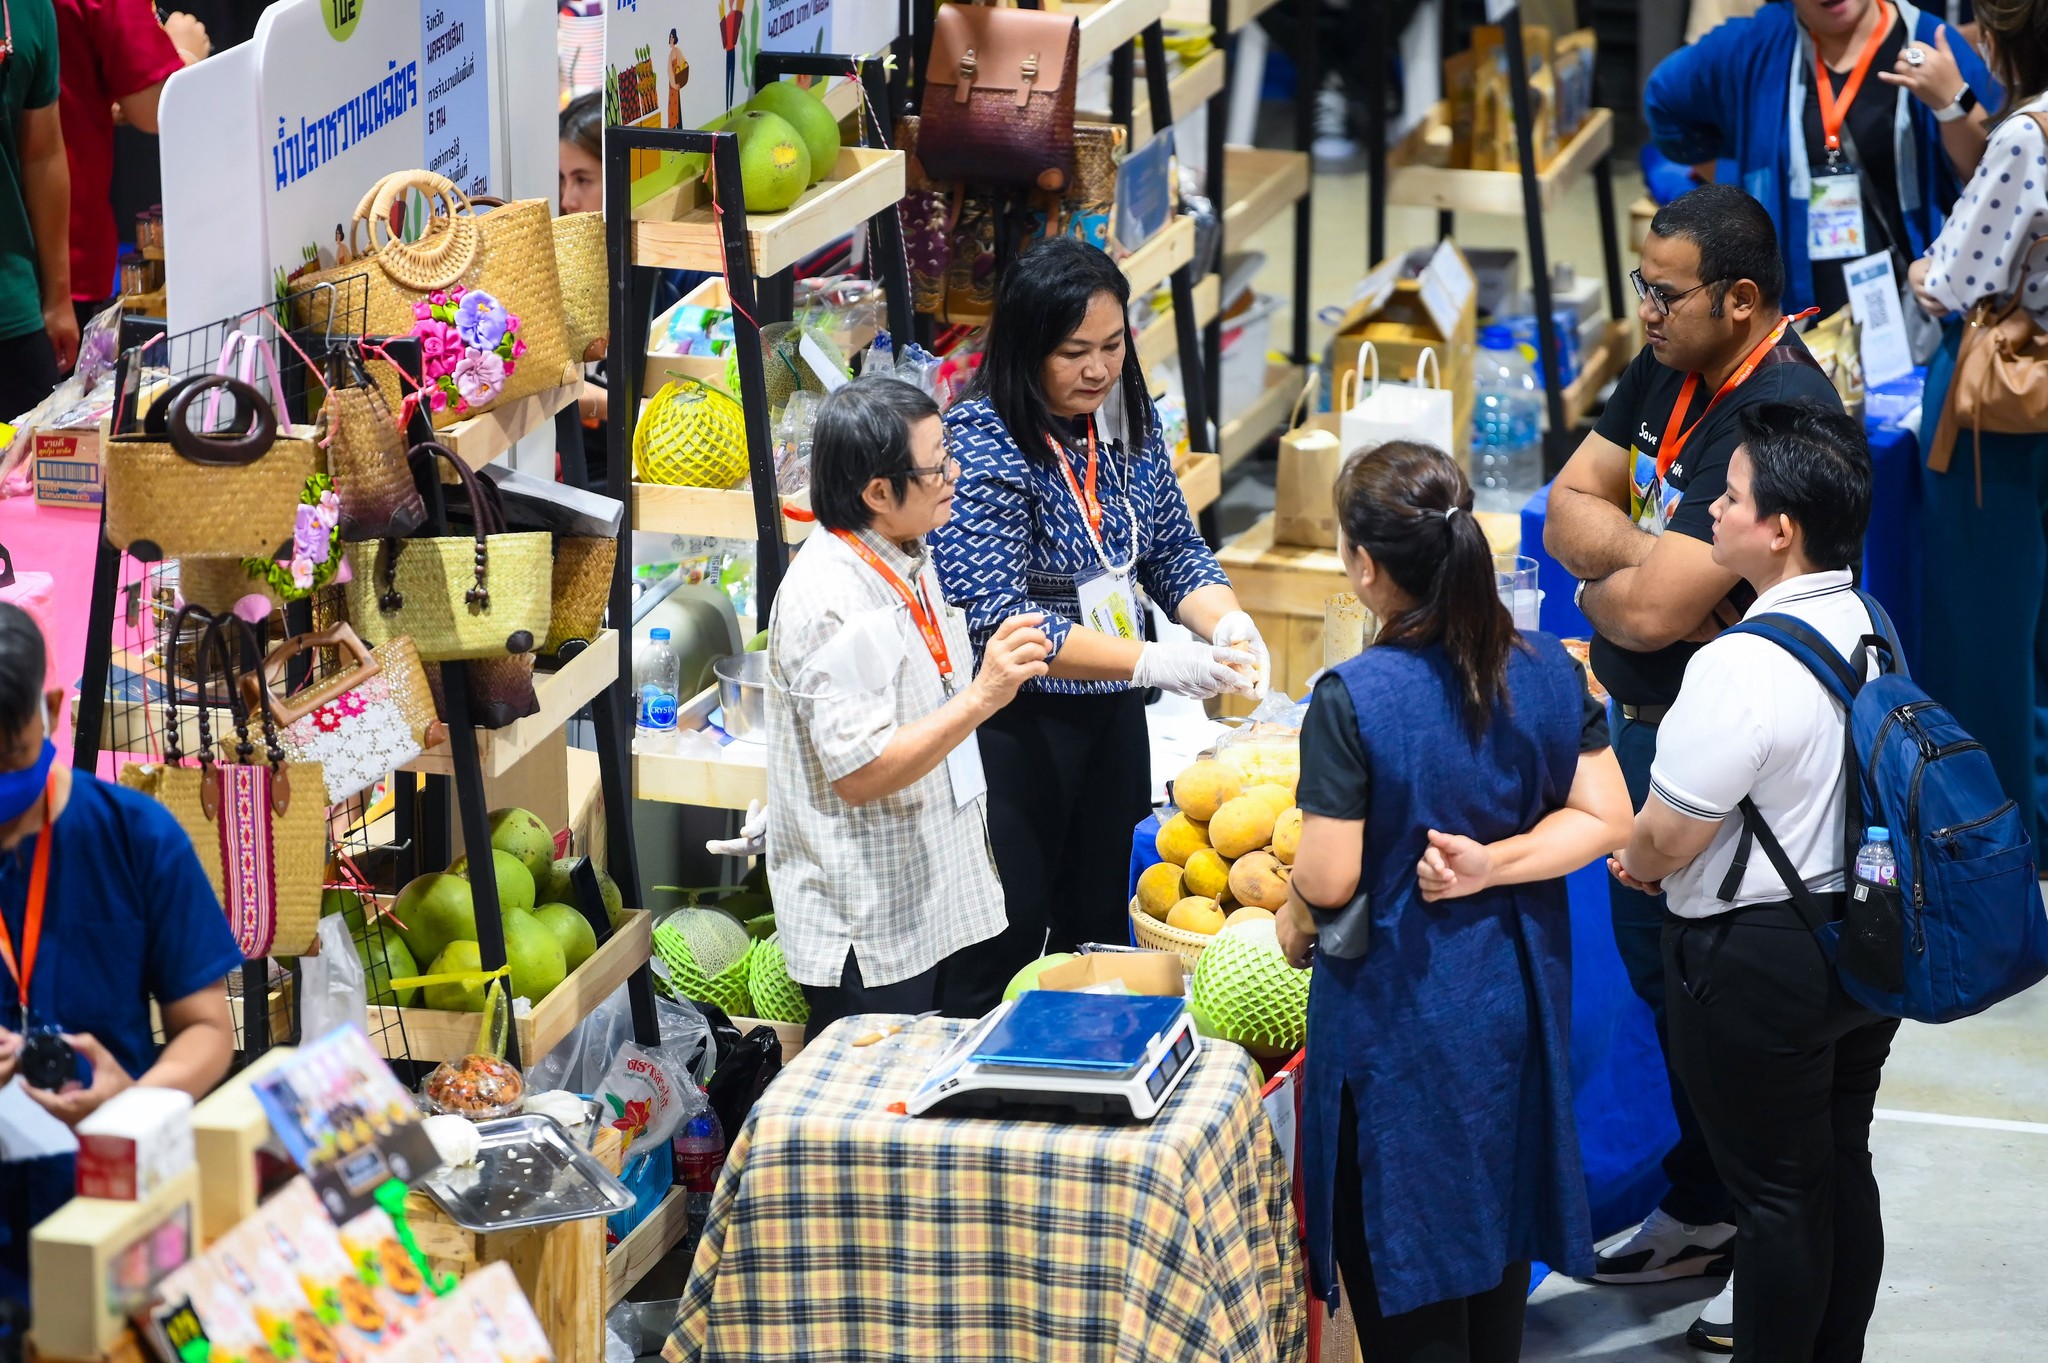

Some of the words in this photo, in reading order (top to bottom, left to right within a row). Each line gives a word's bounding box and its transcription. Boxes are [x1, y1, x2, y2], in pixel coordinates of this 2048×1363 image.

[426, 9, 444, 32] จังหวัด
[427, 20, 464, 65] นครราชสีมา
[428, 111, 434, 135] 6
[436, 105, 446, 130] คน
[1638, 421, 1658, 446] Save
